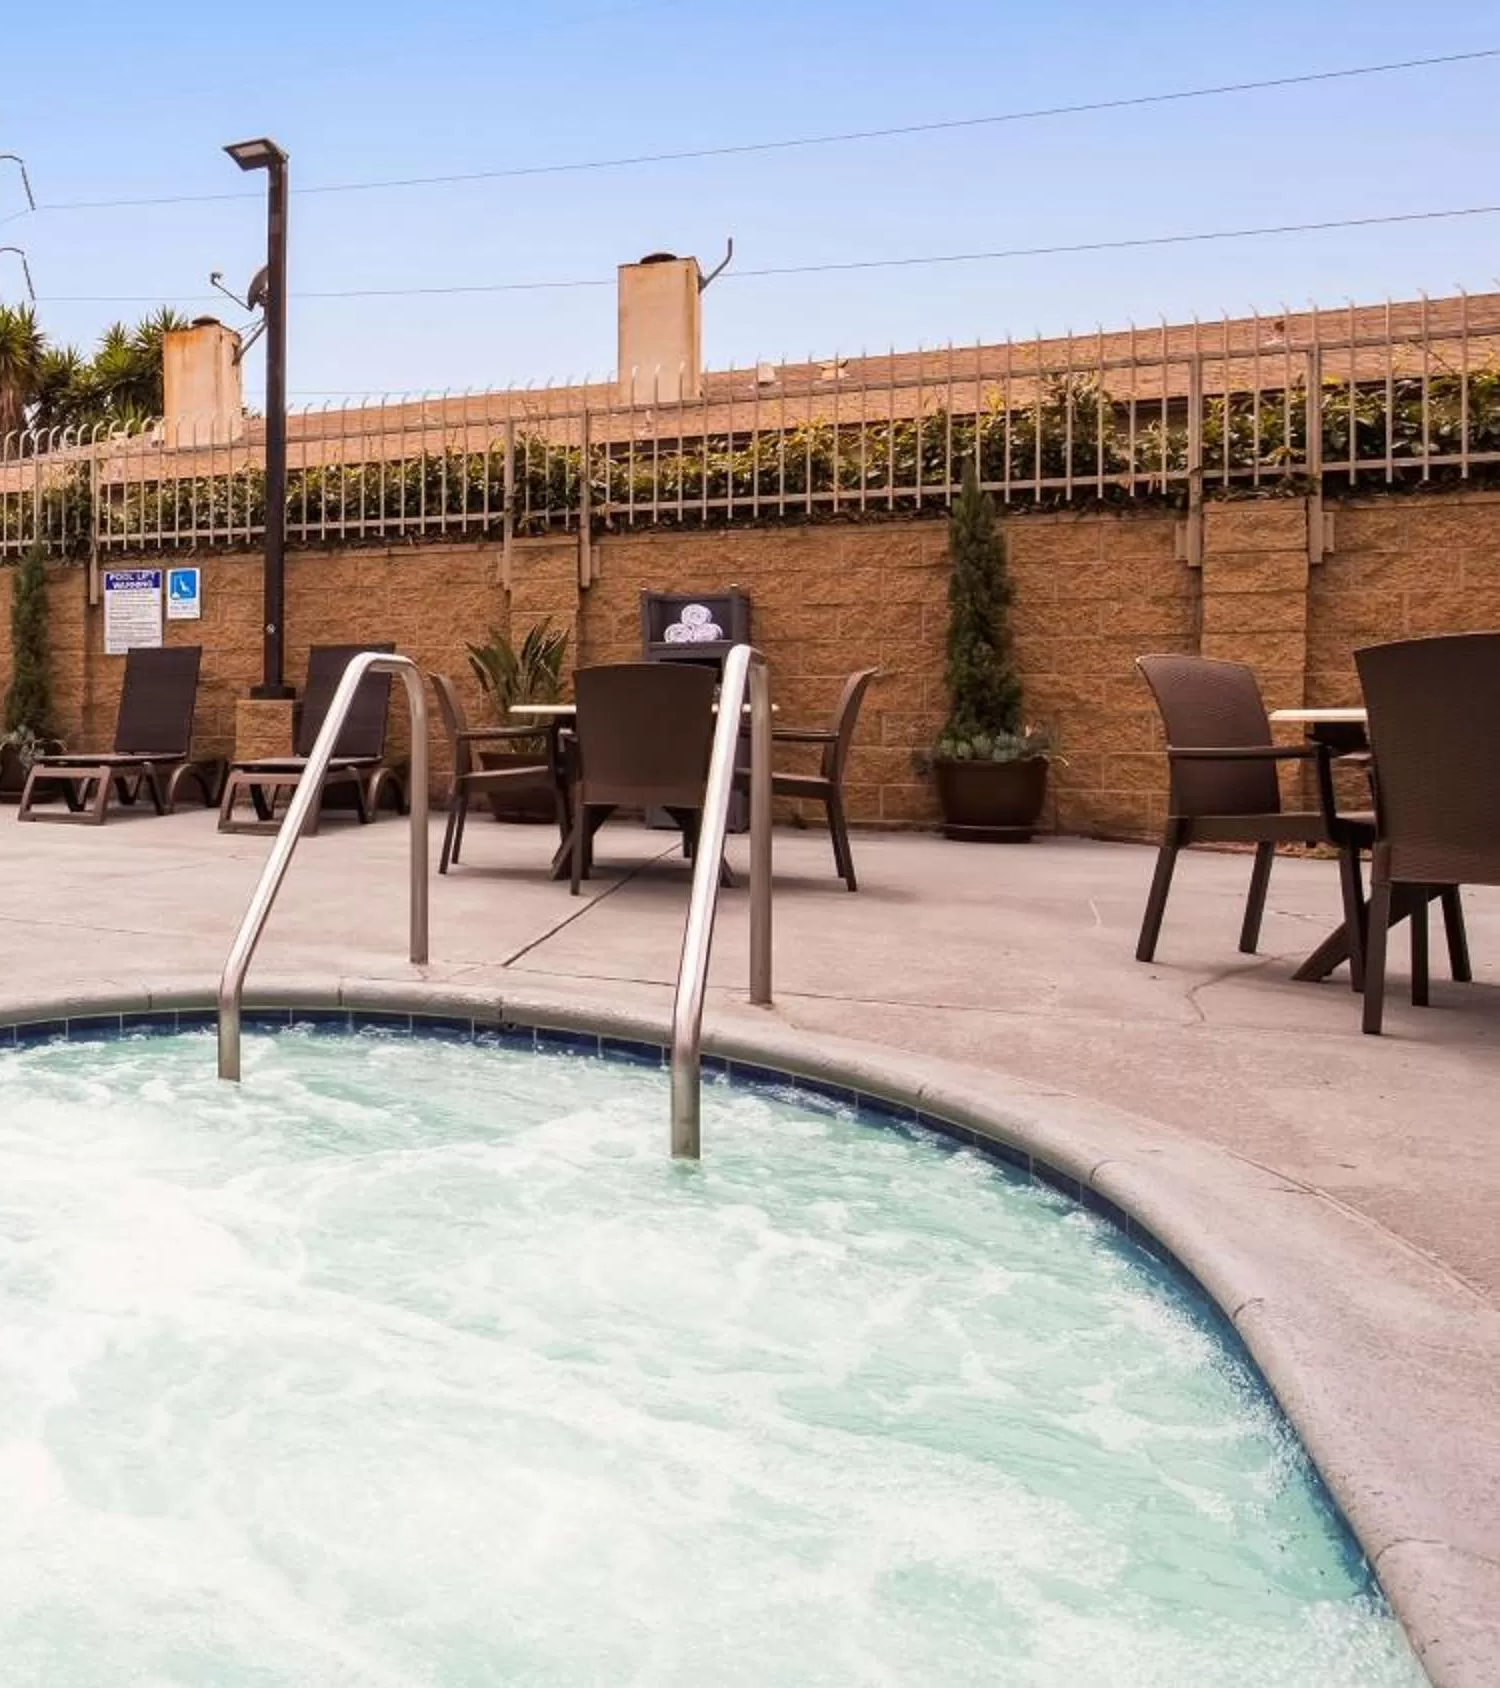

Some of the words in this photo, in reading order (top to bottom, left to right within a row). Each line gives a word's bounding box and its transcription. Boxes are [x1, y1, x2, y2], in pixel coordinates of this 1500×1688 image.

[109, 572, 135, 581] POOL
[137, 571, 155, 580] LIFT
[111, 580, 153, 590] WARNING
